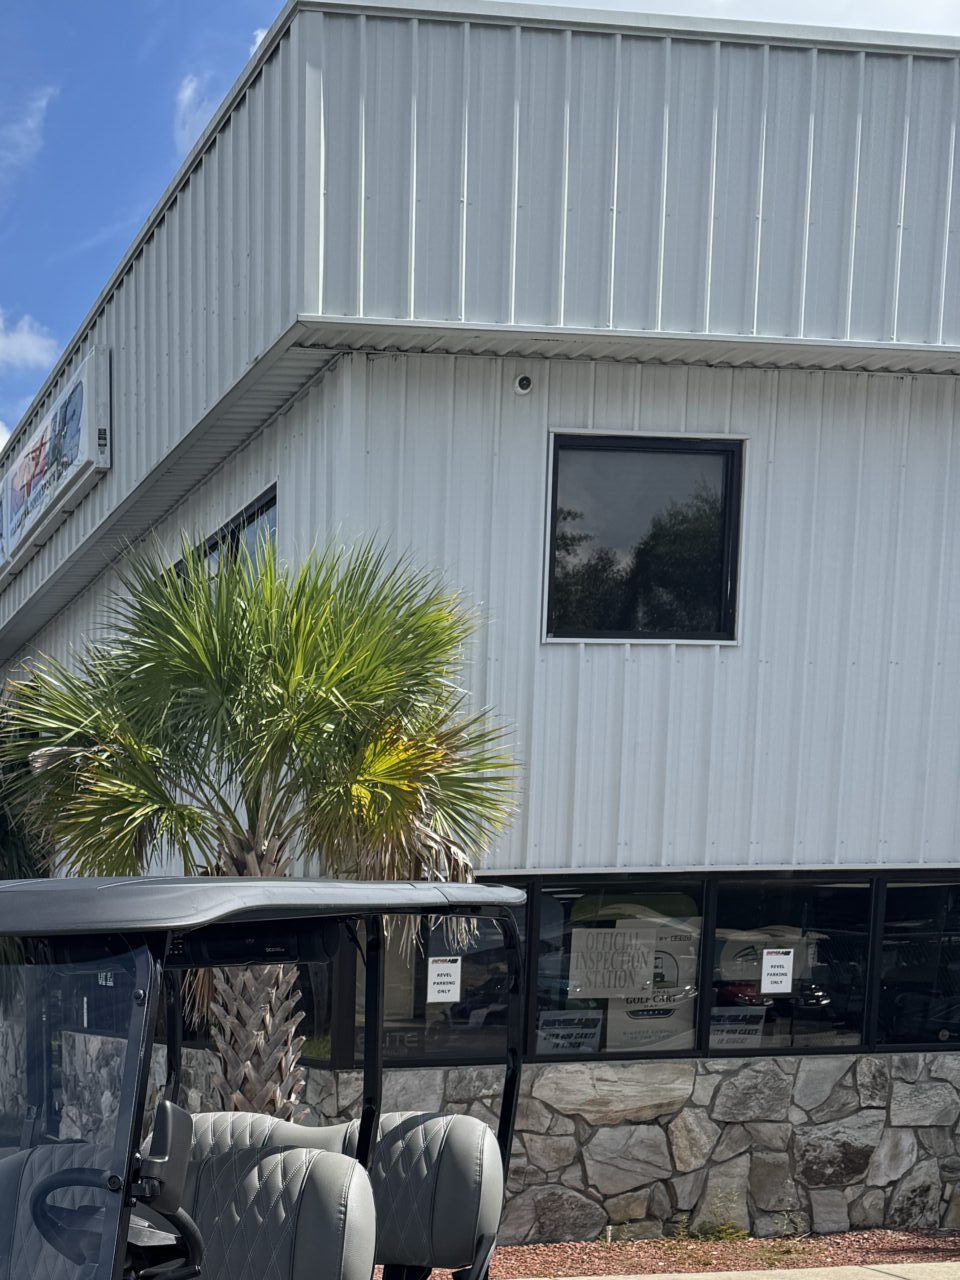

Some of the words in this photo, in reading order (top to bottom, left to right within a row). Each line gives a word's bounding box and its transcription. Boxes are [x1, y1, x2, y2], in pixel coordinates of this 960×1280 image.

[585, 932, 641, 950] OFFICIAL
[575, 951, 649, 970] INSPECTION
[585, 970, 636, 989] STATION
[625, 996, 650, 1005] GOLF
[652, 994, 677, 1003] CART
